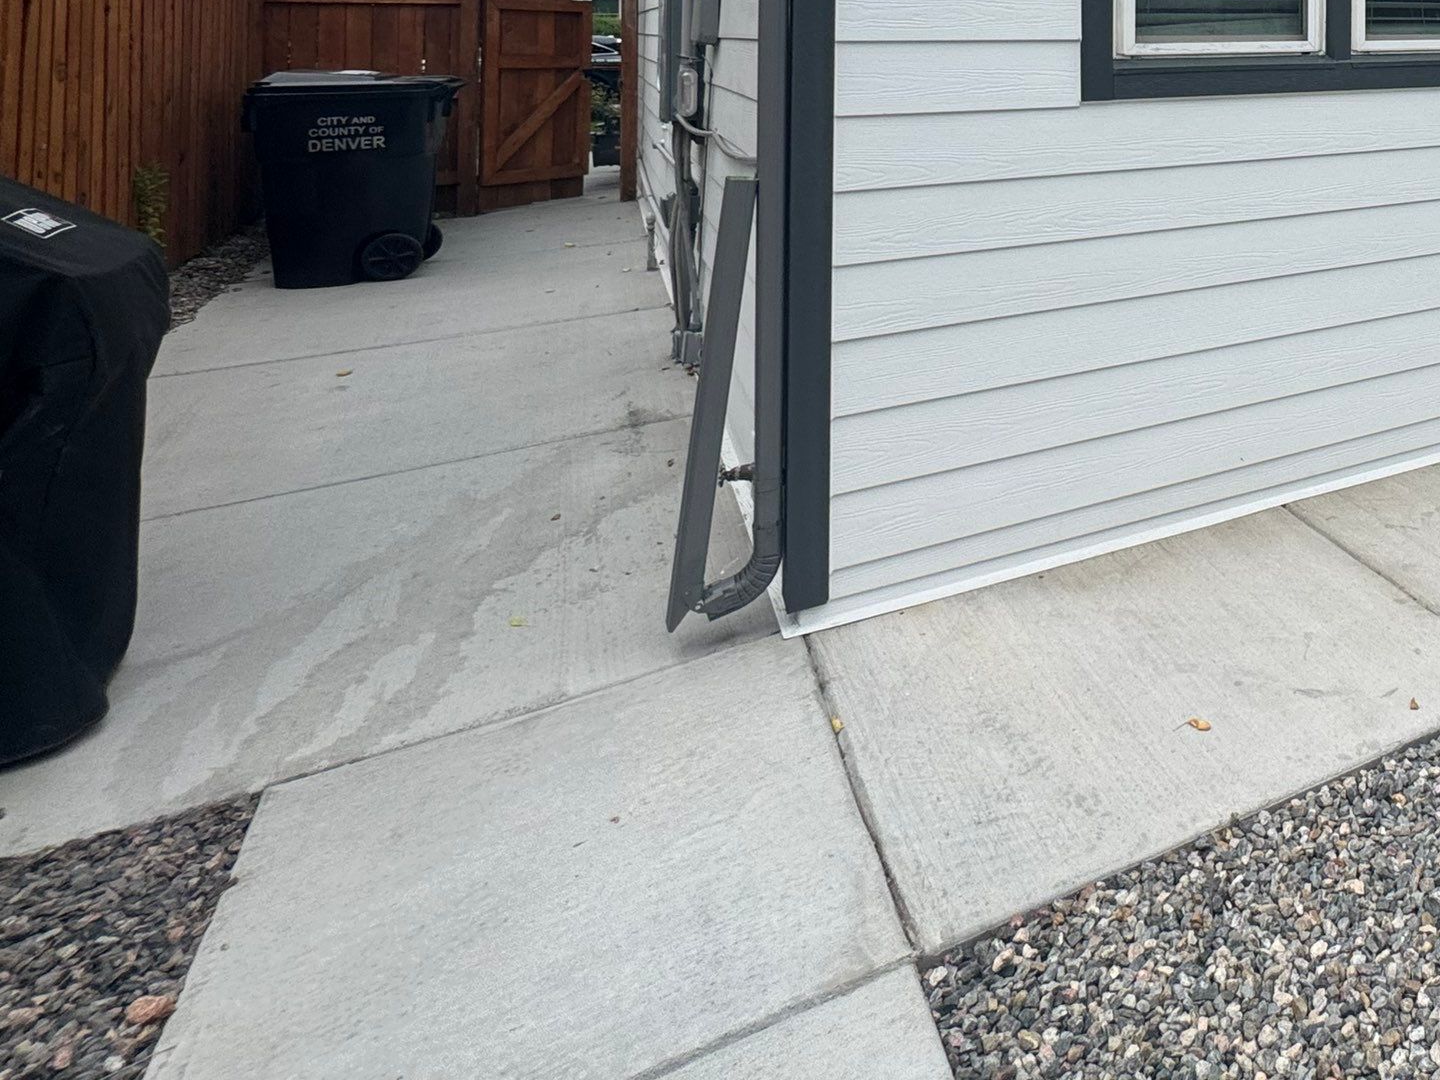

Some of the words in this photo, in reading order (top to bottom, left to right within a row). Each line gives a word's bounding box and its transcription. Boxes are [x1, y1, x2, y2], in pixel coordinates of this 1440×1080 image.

[316, 116, 349, 126] CITY
[351, 116, 376, 124] AND
[308, 126, 366, 137] COUNTY
[369, 126, 385, 134] OF
[308, 136, 386, 152] DENVER
